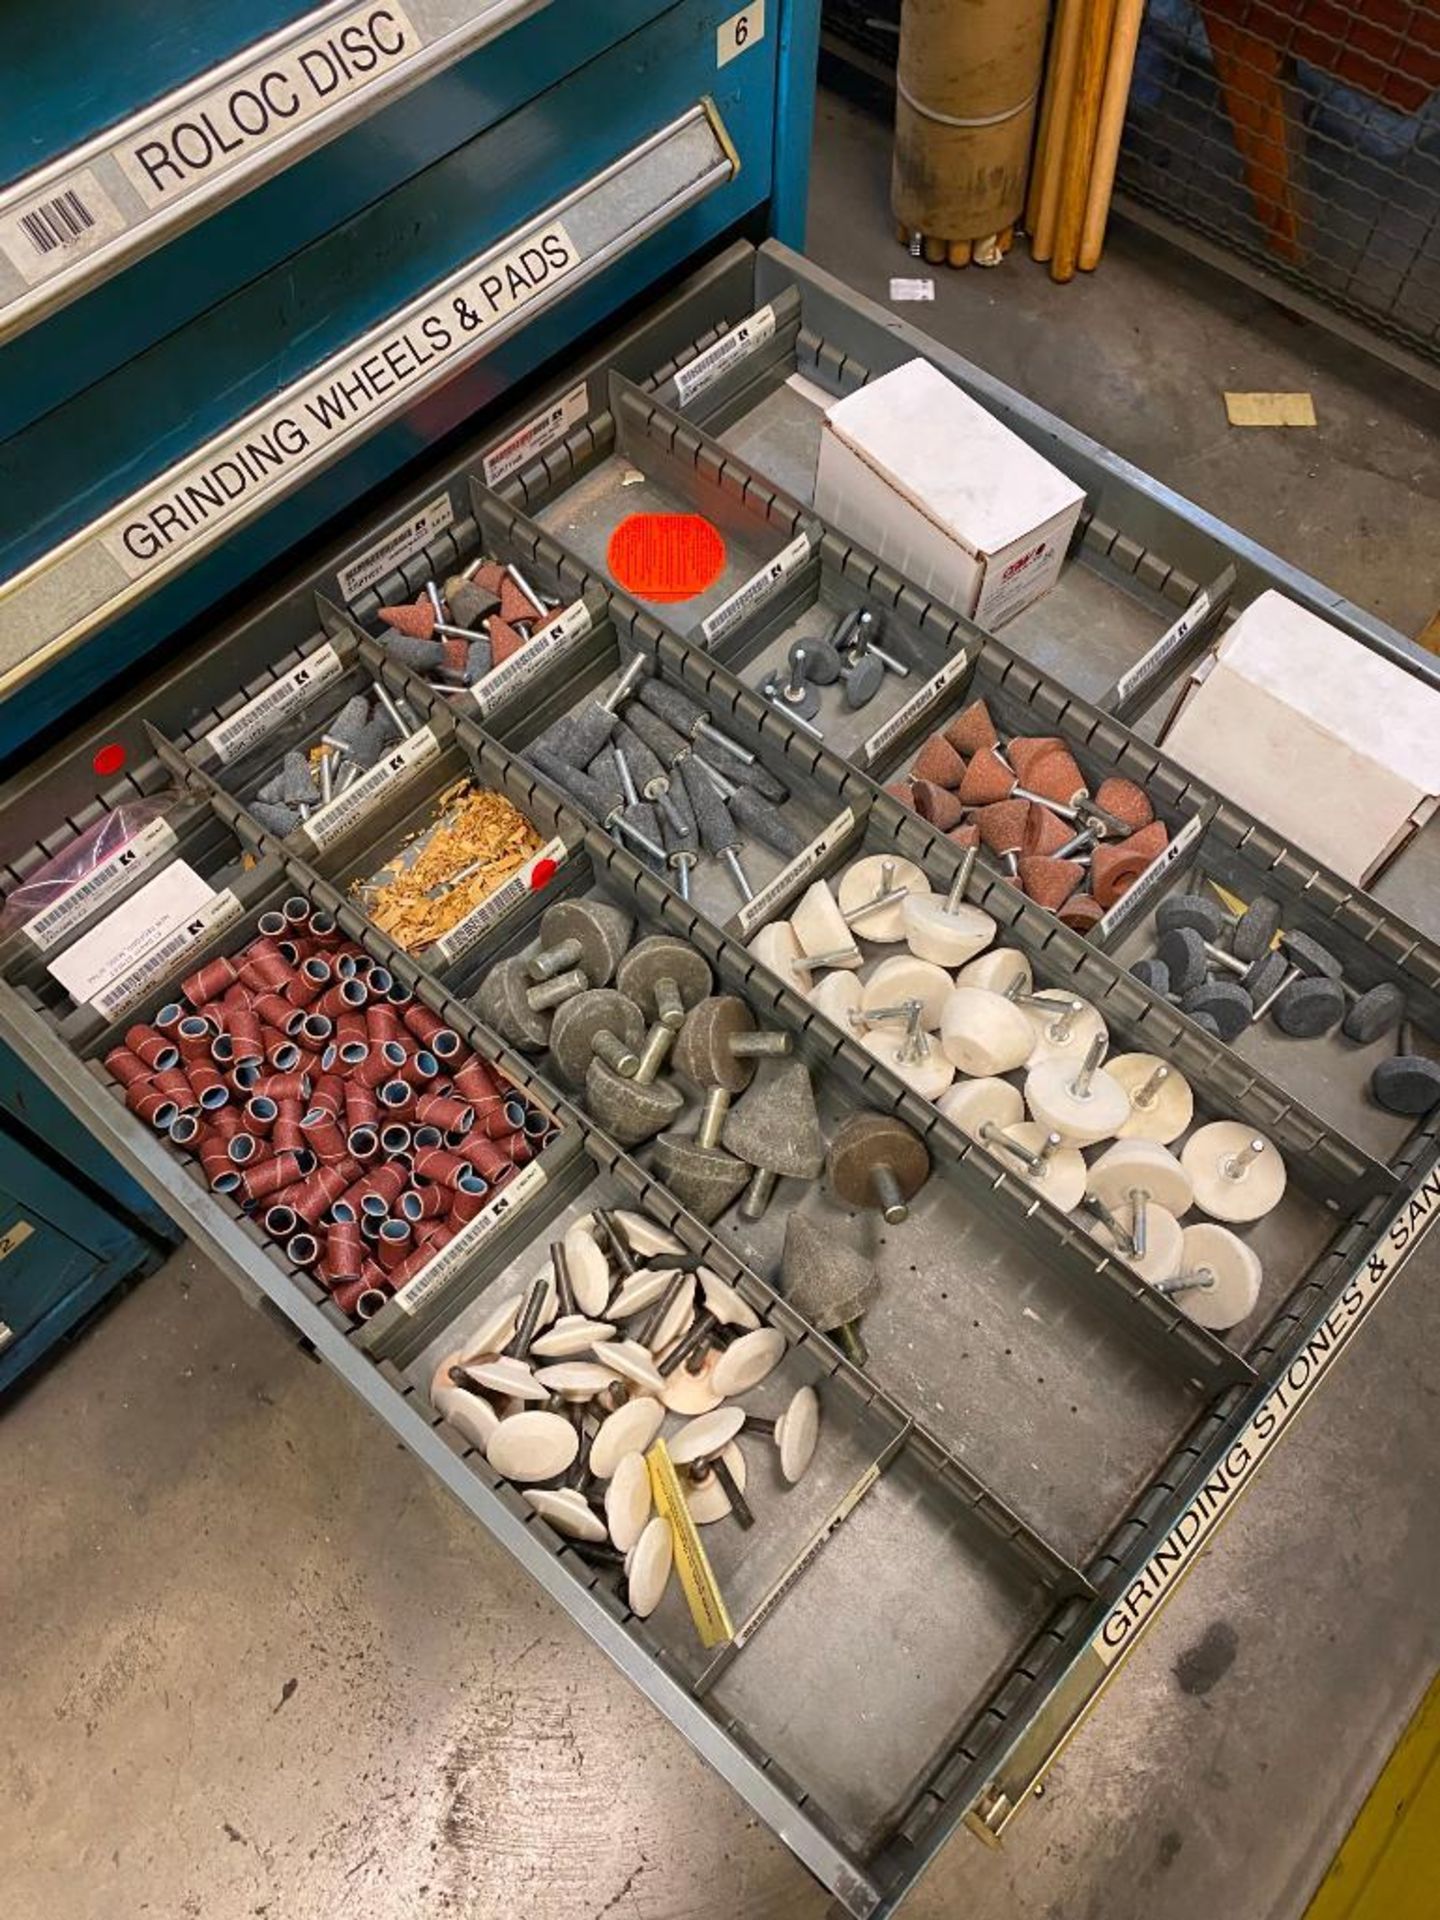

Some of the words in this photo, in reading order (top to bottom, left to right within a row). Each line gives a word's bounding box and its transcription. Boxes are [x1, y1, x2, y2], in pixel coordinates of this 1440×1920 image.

[134, 72, 300, 191] ROLOC
[297, 10, 405, 98] DISC
[735, 16, 748, 46] 6
[122, 419, 310, 560] GRINDING
[304, 316, 453, 430] WHEELS
[453, 297, 483, 331] &
[480, 234, 570, 312] PADS
[1102, 1440, 1252, 1648] GRINDING
[1251, 1281, 1366, 1440] STONES
[1367, 1253, 1388, 1283] &
[1389, 1164, 1440, 1250] SAN
